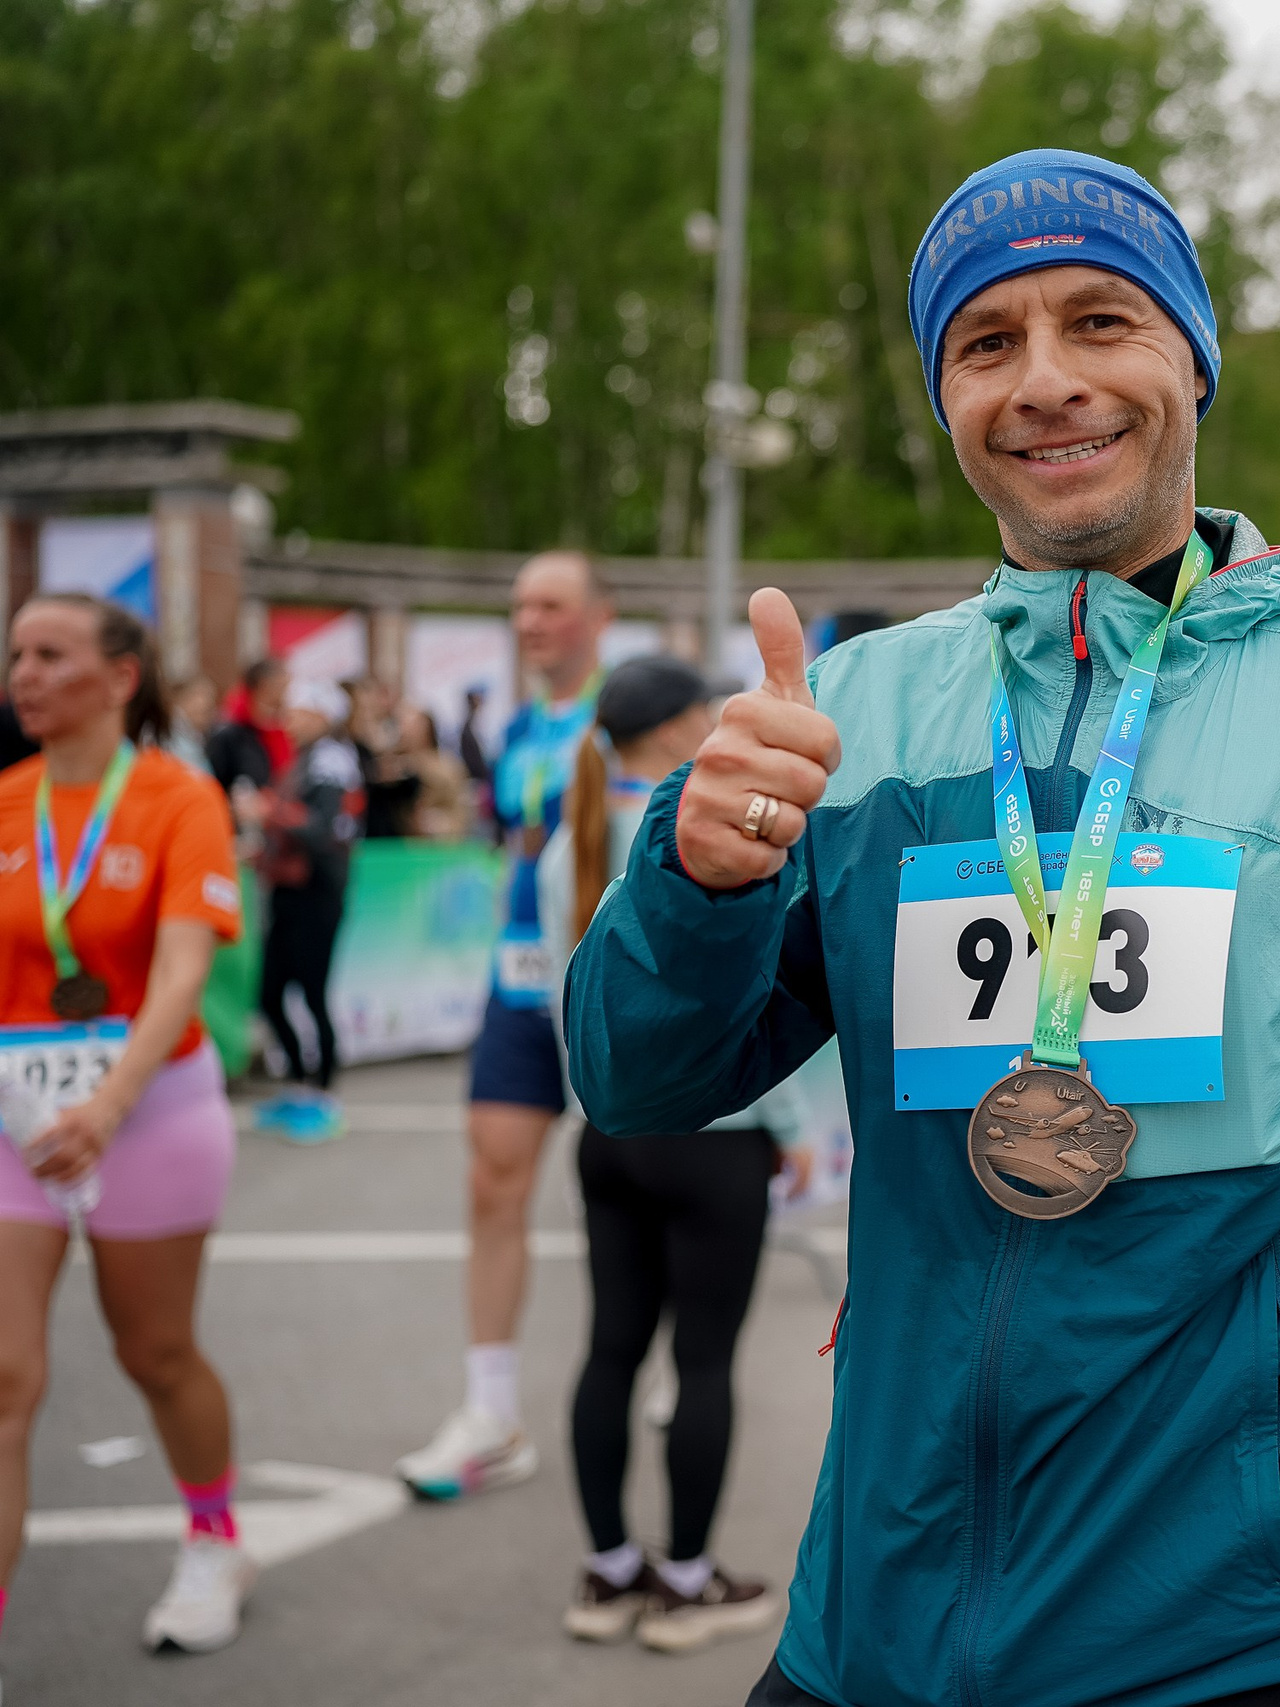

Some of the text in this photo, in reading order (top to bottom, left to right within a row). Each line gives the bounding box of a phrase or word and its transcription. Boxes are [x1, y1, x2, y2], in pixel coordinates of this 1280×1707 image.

[927, 177, 1165, 270] ERDINGER
[1118, 708, 1138, 740] Utair
[1006, 793, 1021, 834] СБЕР
[1089, 801, 1112, 847] СБЕР
[976, 860, 1004, 875] СБЕ
[1040, 850, 1069, 861] зелён
[1041, 860, 1067, 871] араф
[1069, 870, 1094, 941] 185 лет
[957, 908, 1150, 1021] 93
[1054, 967, 1069, 1010] марафон
[1062, 974, 1077, 1015] зелёный
[1056, 1086, 1085, 1101] Utair
